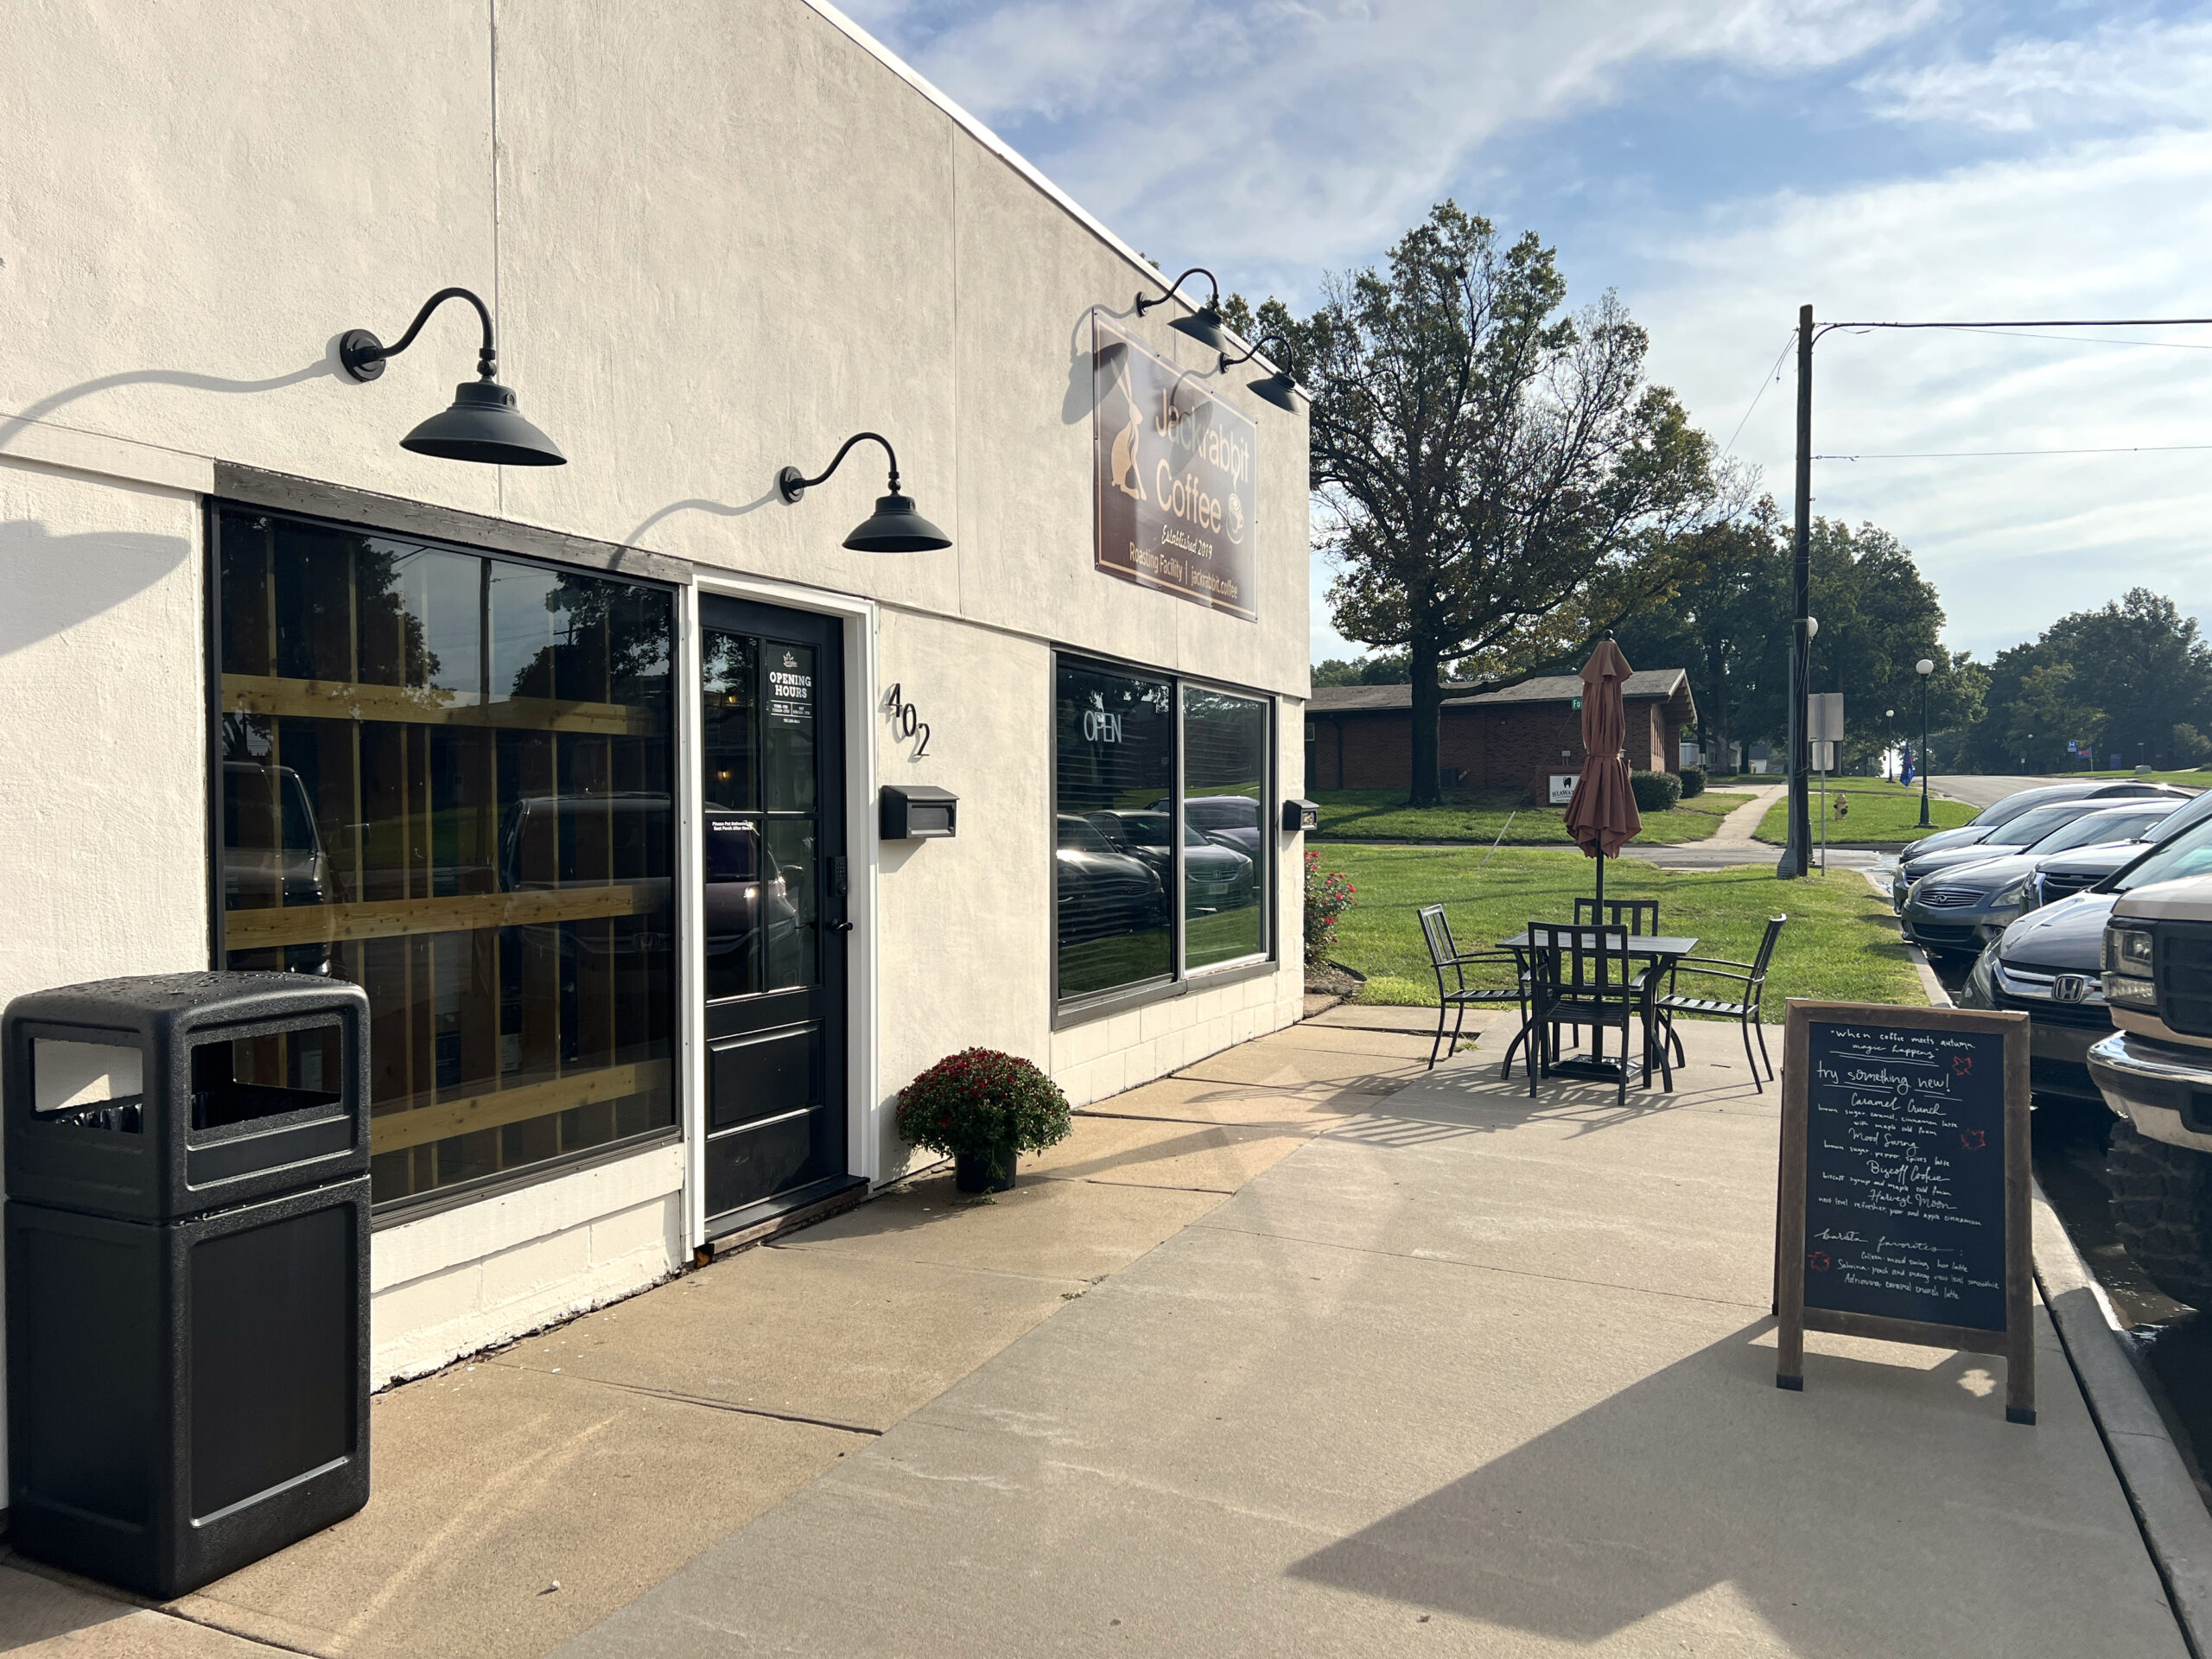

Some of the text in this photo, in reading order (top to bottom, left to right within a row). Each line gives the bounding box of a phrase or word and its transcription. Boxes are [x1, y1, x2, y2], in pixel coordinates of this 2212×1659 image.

[1155, 388, 1249, 484] Jackrabbit
[1156, 458, 1222, 534] Coffee
[1161, 524, 1213, 560] Established 2019
[1129, 542, 1158, 574] Roasting
[1160, 554, 1183, 582] Facility
[1191, 566, 1238, 599] jackrabbit.coffee
[769, 671, 811, 687] OPENING
[775, 684, 807, 698] HOURS
[1573, 699, 1582, 709] Fo
[884, 683, 931, 756] 402
[1084, 710, 1122, 743] OPEN
[1853, 1044, 1886, 1054] magic
[1879, 1033, 1904, 1042] coffee
[1911, 1035, 1935, 1045] meets
[1816, 1060, 1950, 1095] try something new!
[1818, 1103, 1838, 1113] brown
[1901, 1117, 1937, 1126] cinnamon
[1851, 1092, 1947, 1116] Caramel Crunch
[1848, 1128, 1919, 1157] Mood Swing
[1918, 1127, 1937, 1135] foam
[1824, 1140, 1844, 1150] brown
[1934, 1156, 1950, 1166] latte
[1822, 1172, 1845, 1181] biscoff
[1849, 1177, 1871, 1185] syrup
[1888, 1183, 1909, 1192] maple
[1932, 1187, 1952, 1196] foam
[1866, 1160, 1950, 1185] Biscoff Cookie
[1867, 1189, 1957, 1210] Harvest Moon
[1835, 1198, 1848, 1206] level
[1923, 1212, 1940, 1222] apple
[1944, 1216, 1982, 1226] cinnamon
[1814, 1228, 1869, 1243] barista
[1909, 1259, 1929, 1270] swing
[1937, 1259, 1948, 1268] hot
[1952, 1262, 1969, 1273] latte
[1885, 1281, 1911, 1292] caramel
[1916, 1285, 1939, 1296] crunch
[1943, 1287, 1960, 1300] latte
[1951, 1274, 1964, 1284] level
[1967, 1278, 2000, 1290] smoothie
